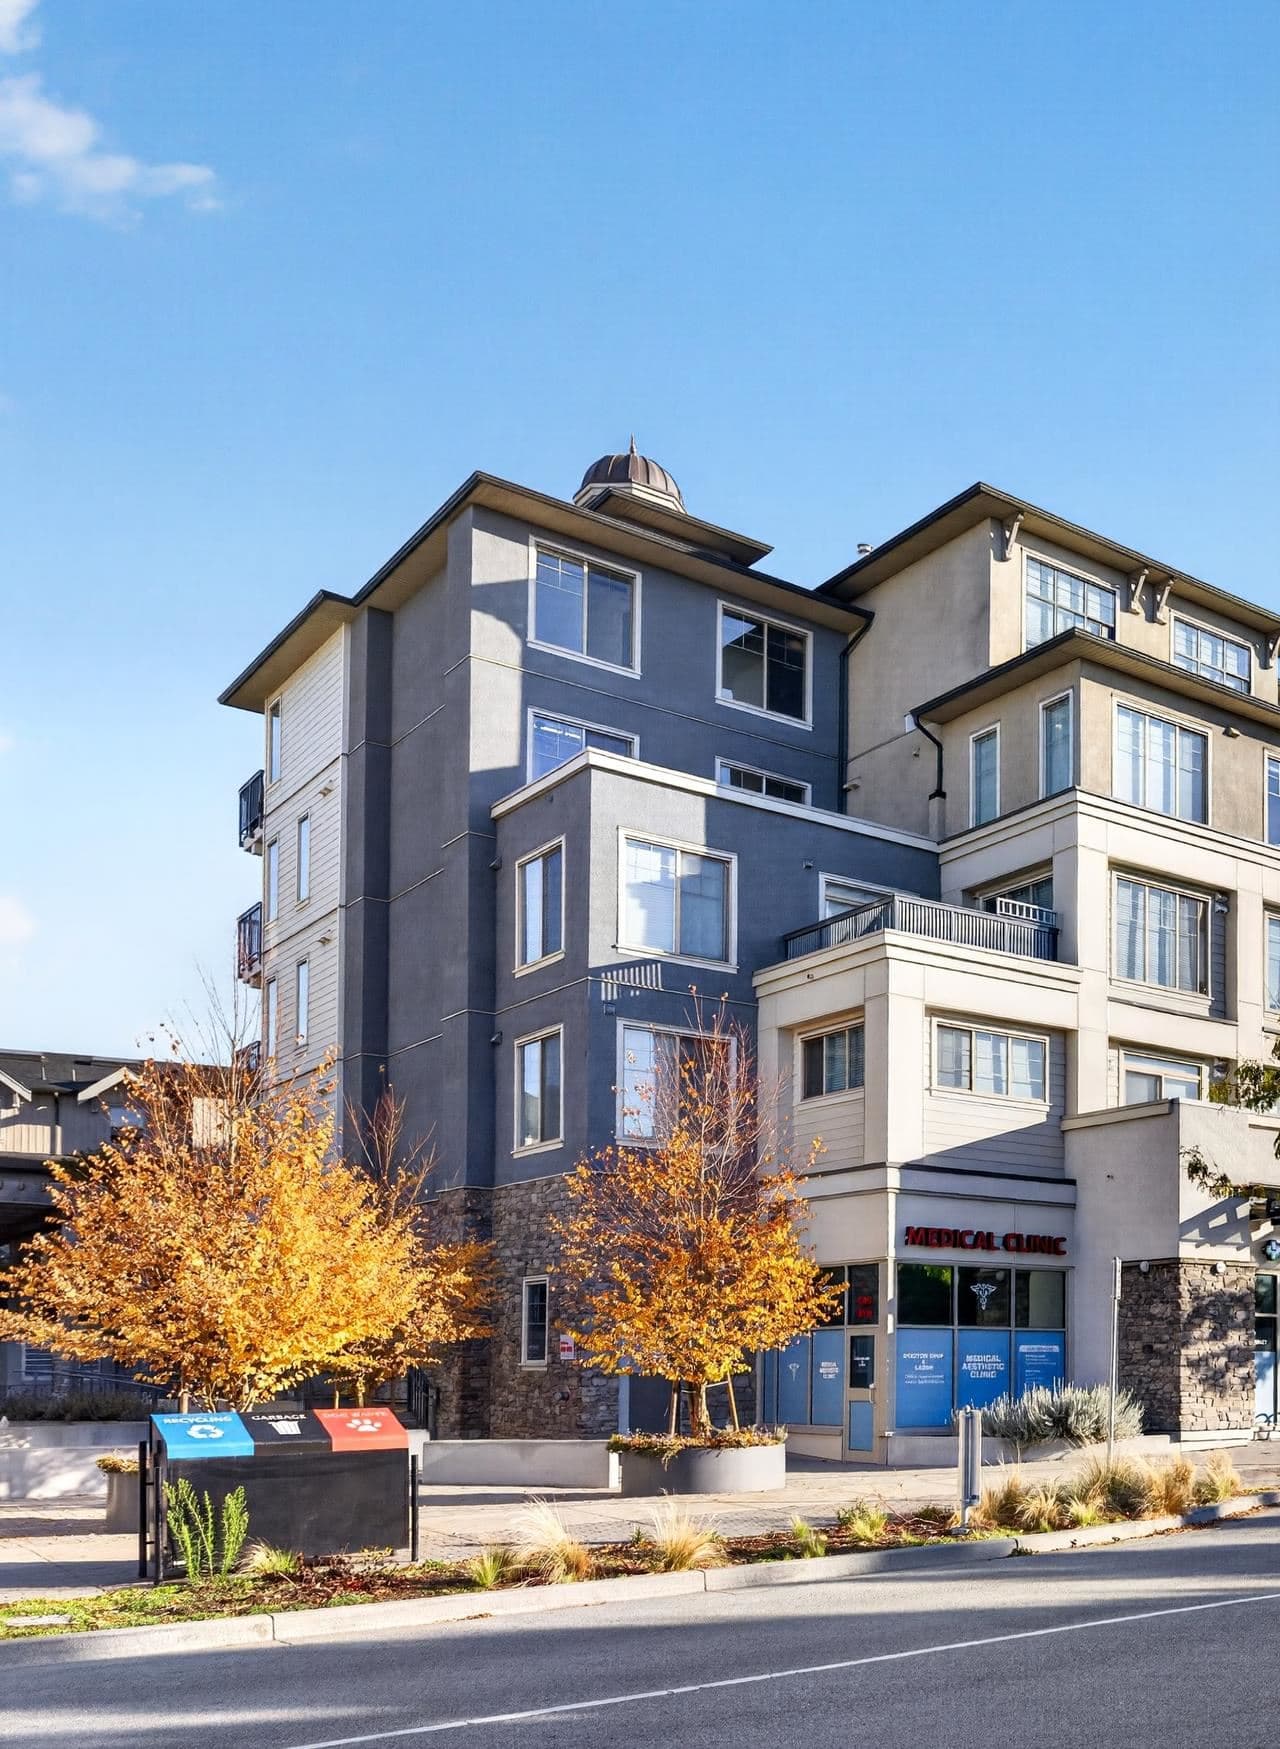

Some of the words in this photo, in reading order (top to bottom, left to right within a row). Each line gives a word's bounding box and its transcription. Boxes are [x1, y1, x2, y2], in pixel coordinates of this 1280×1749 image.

[905, 1226, 1000, 1250] MEDICAL
[1003, 1233, 1067, 1256] CLINIC
[163, 1416, 232, 1424] RECYCLING
